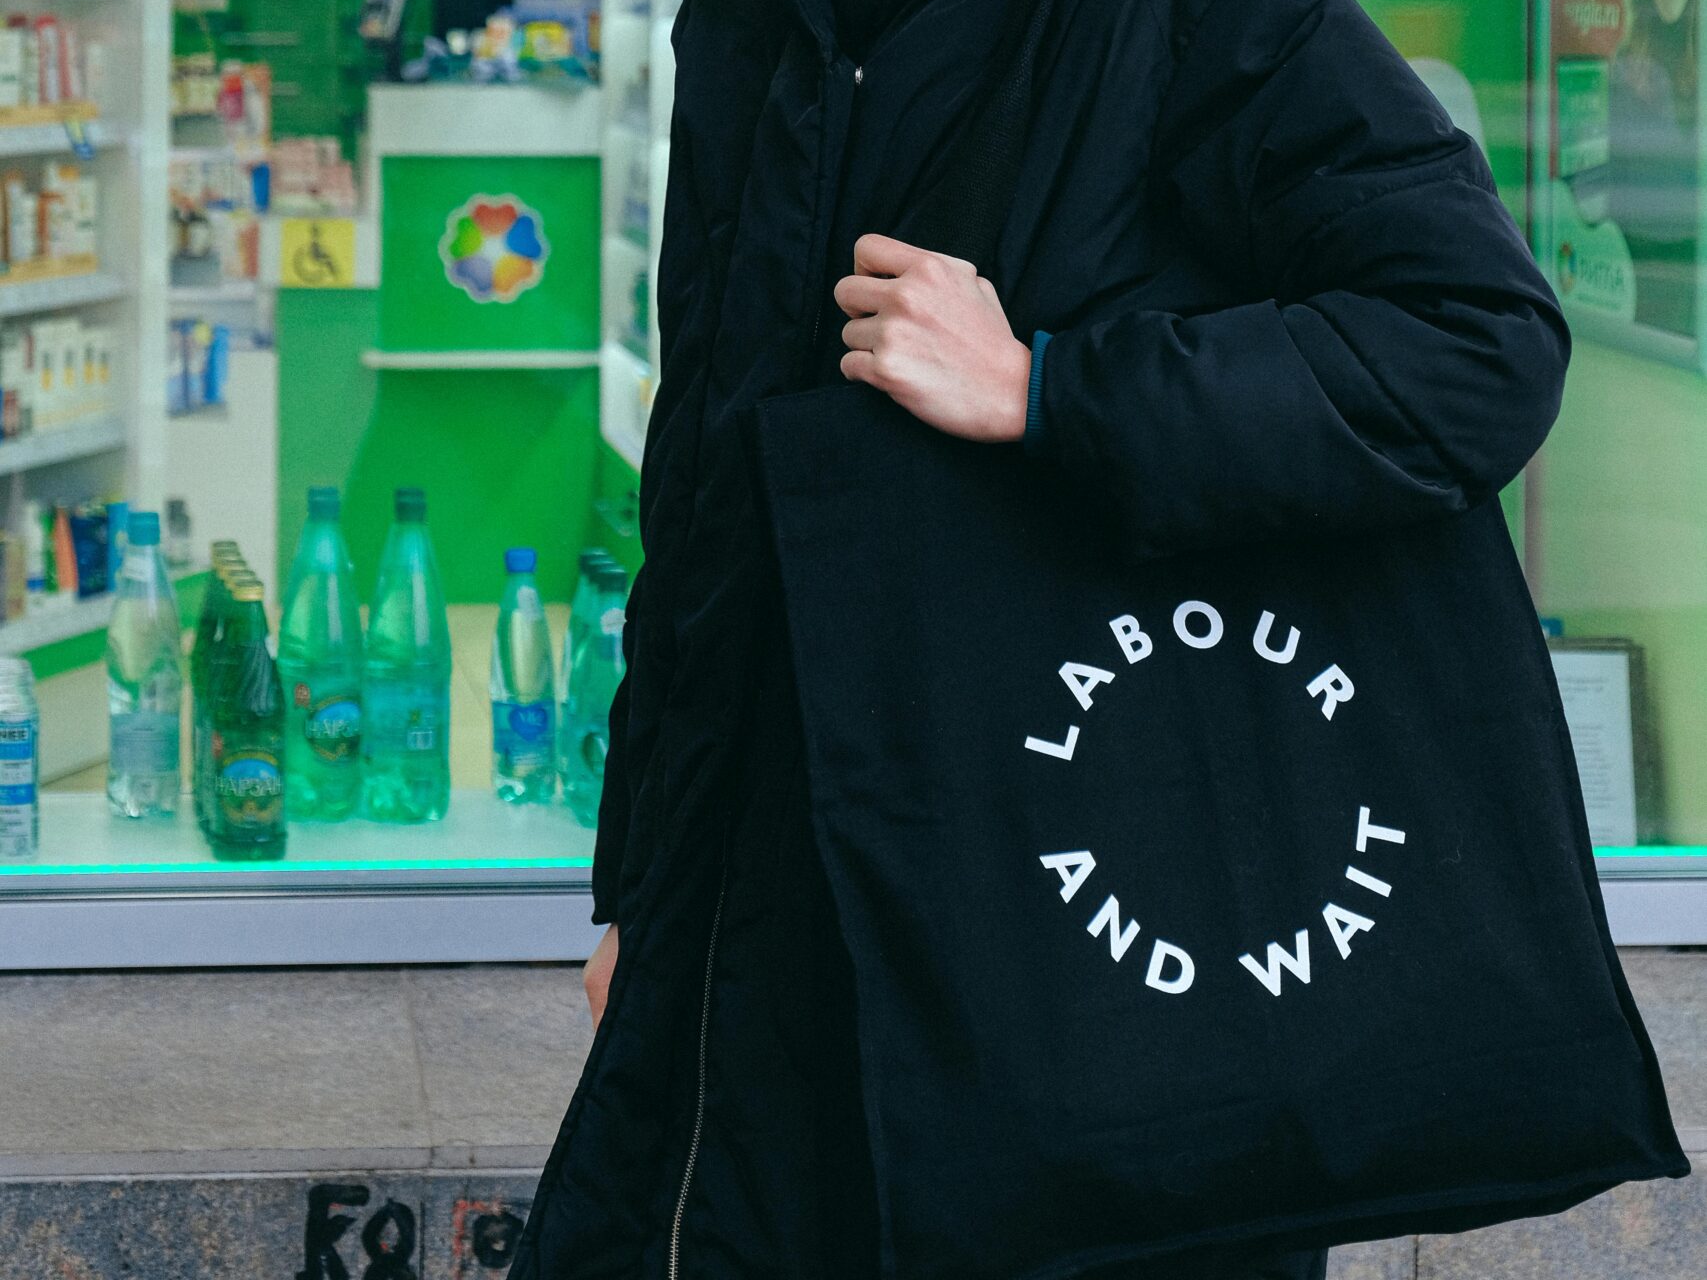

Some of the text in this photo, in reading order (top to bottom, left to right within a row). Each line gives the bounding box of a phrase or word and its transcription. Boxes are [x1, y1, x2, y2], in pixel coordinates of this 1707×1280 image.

[1024, 600, 1355, 761] LABOUR
[1039, 806, 1406, 997] AND WAIT
